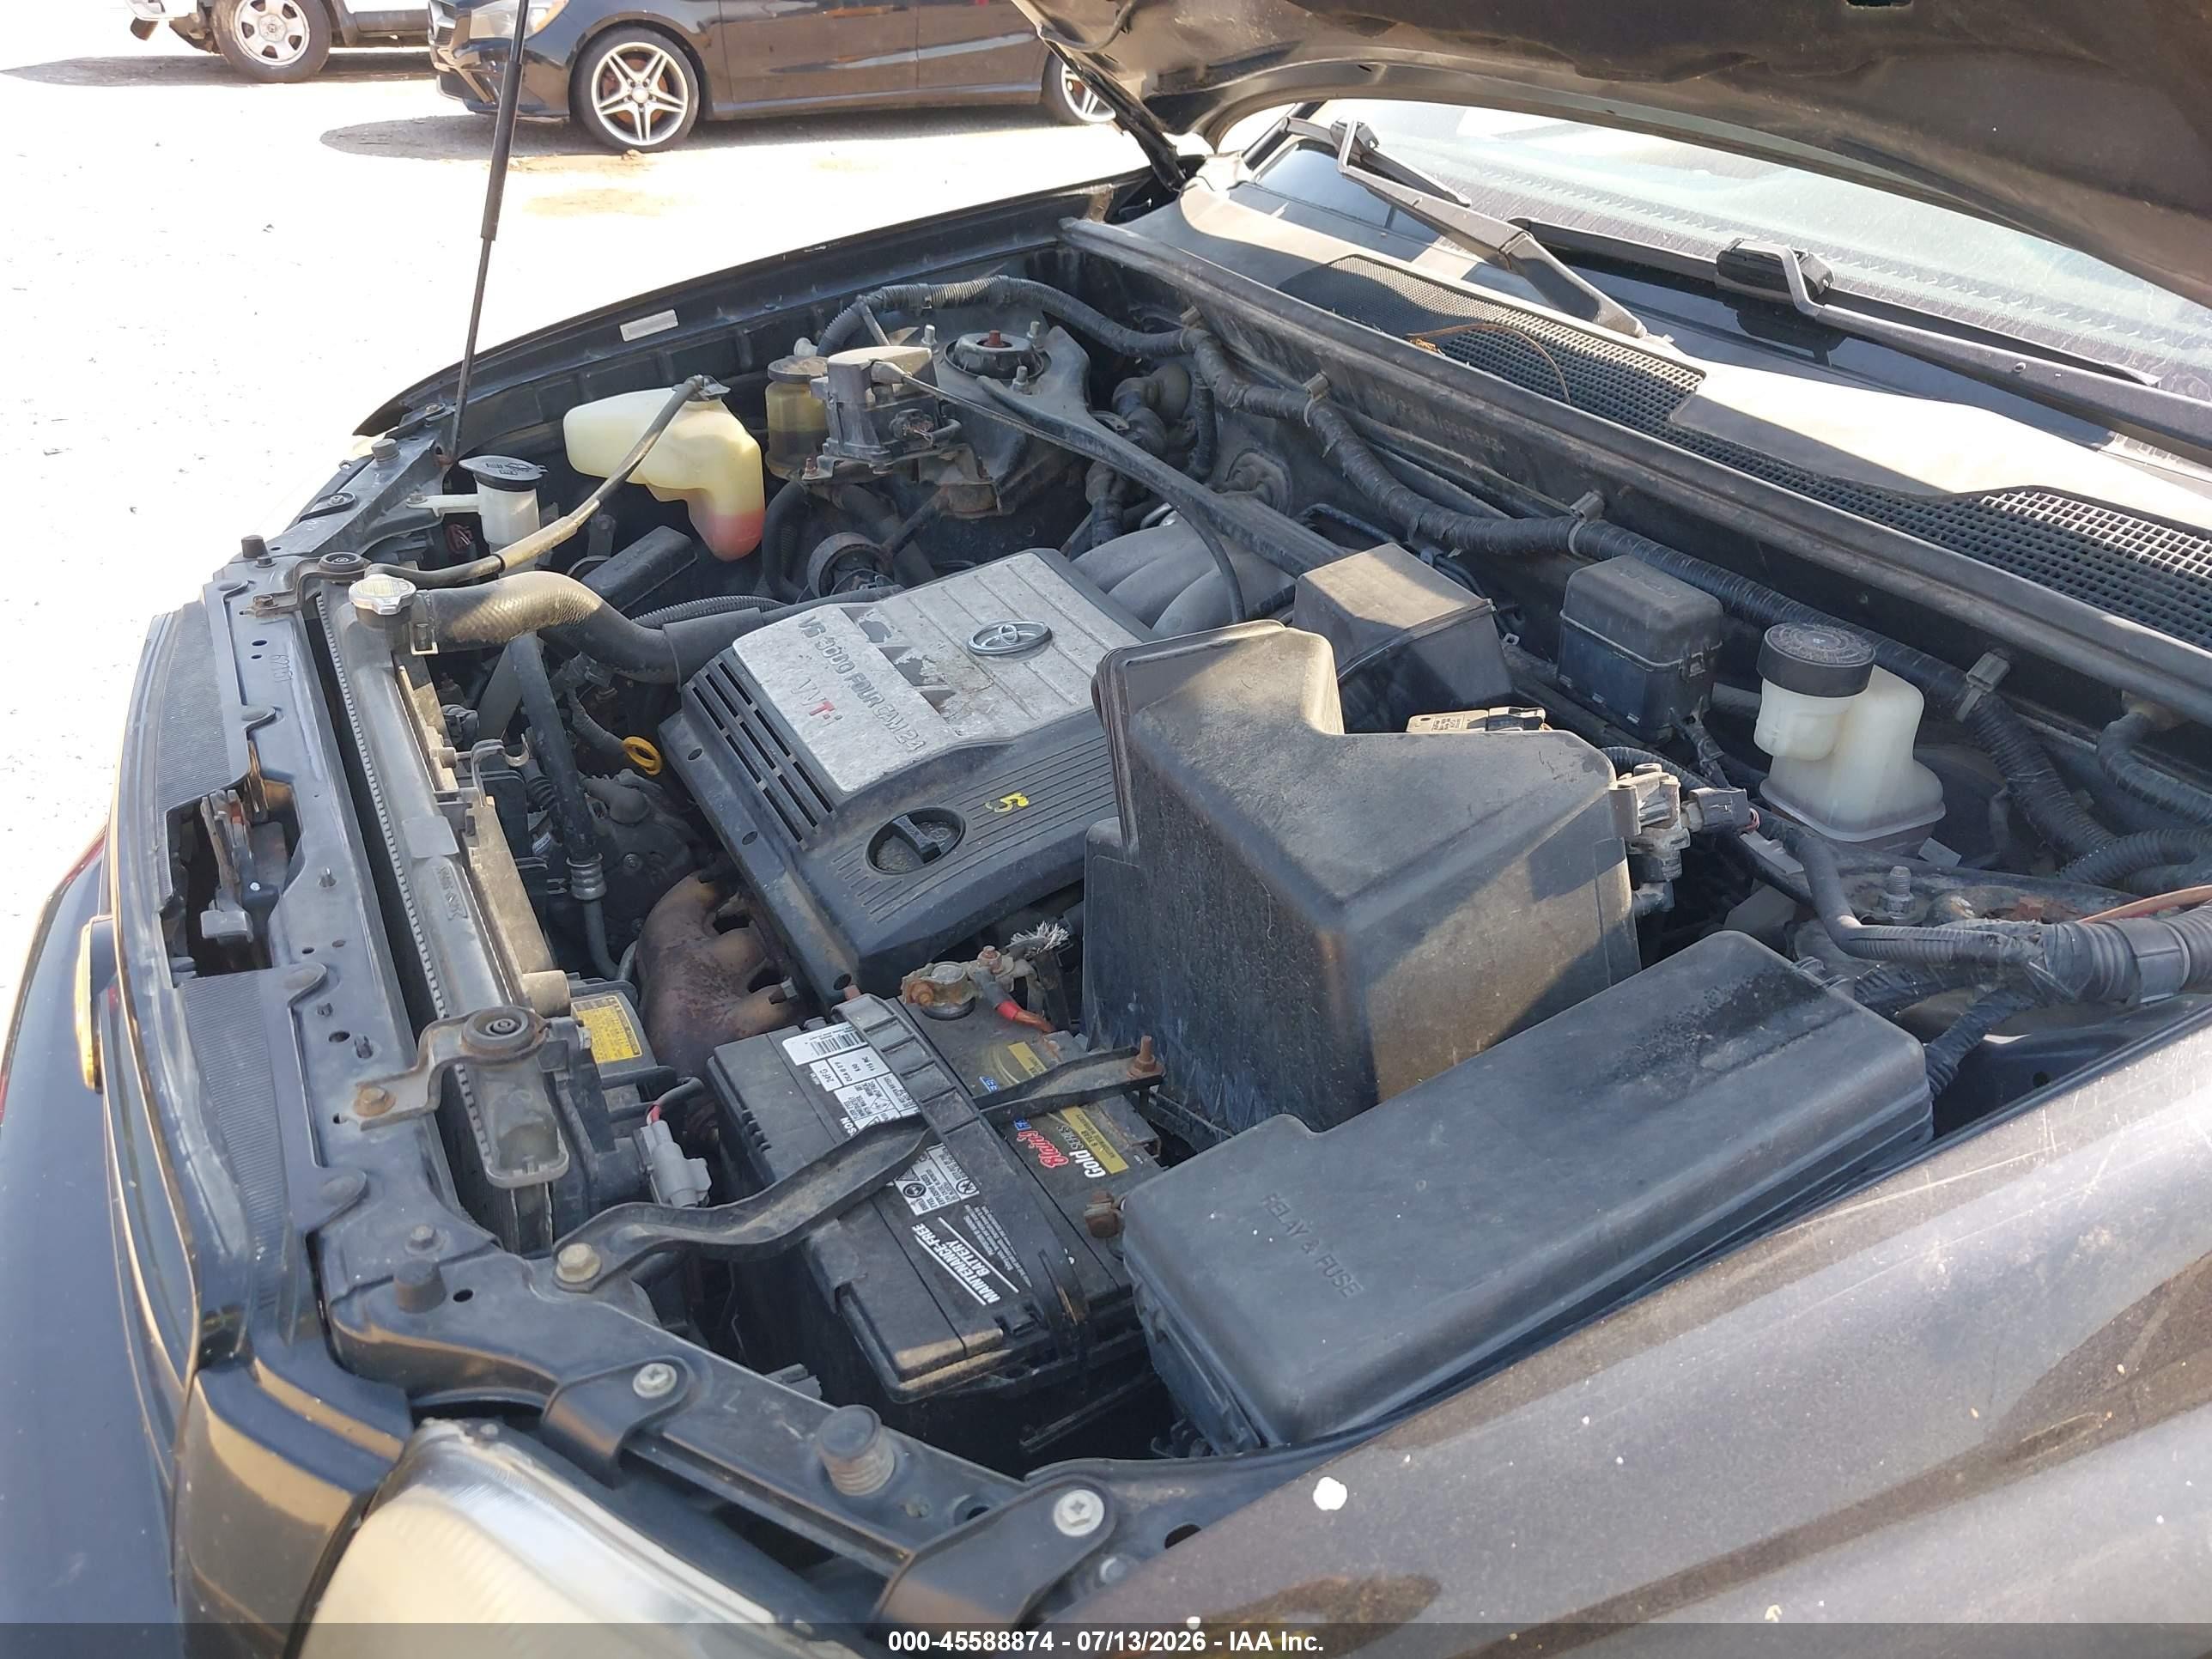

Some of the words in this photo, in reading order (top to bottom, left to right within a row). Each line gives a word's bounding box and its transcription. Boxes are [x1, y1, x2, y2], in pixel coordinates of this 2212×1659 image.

[799, 616, 826, 638] V6
[817, 636, 855, 674] 3000
[844, 672, 884, 708] FOUR
[1017, 1131, 1069, 1168] Blain's
[1057, 1125, 1084, 1151] SERIES
[1069, 1149, 1106, 1178] Gold
[912, 1223, 1000, 1304] MAINTENANCE-FREE
[945, 1239, 990, 1276] BATTERY
[1261, 1193, 1310, 1236] RELAY
[1301, 1239, 1320, 1255] &
[1315, 1255, 1364, 1297] FUSE
